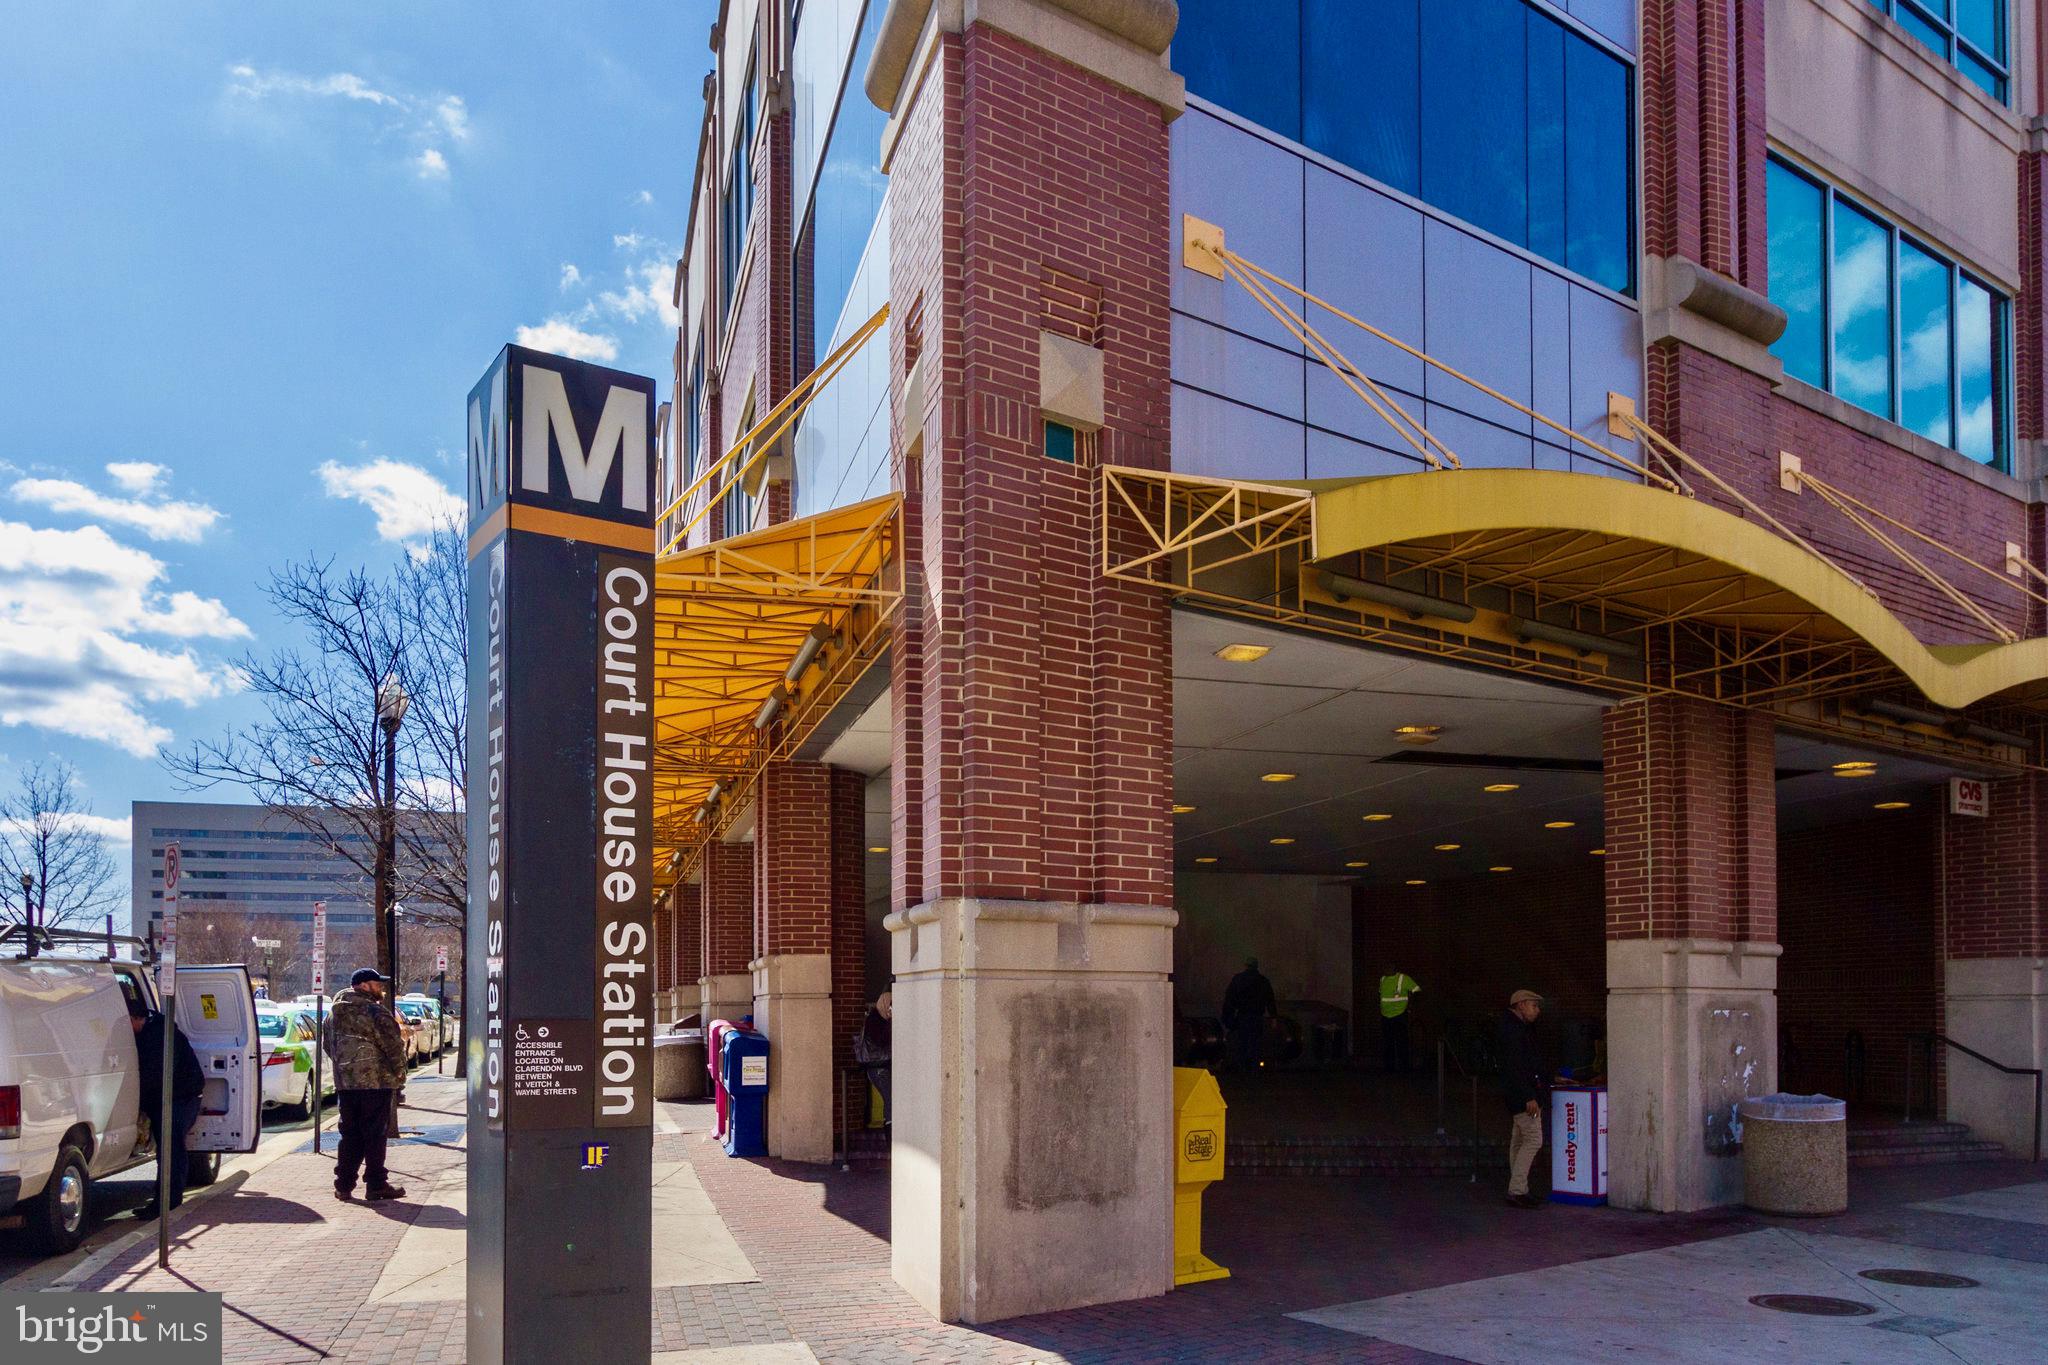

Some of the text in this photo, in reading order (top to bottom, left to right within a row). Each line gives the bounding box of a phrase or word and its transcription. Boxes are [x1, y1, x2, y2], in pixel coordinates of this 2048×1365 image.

[522, 363, 647, 513] M
[468, 365, 504, 525] M
[1959, 781, 1982, 801] CVS
[488, 562, 503, 1118] Court House Station
[602, 566, 649, 1115] Court House Station
[515, 1049, 556, 1057] ENTRANCE
[515, 1057, 550, 1065] LOCATED
[564, 1064, 584, 1072] BLVD
[543, 1088, 577, 1096] STREETS
[1194, 1134, 1212, 1145] Real
[1188, 1144, 1213, 1155] Estate
